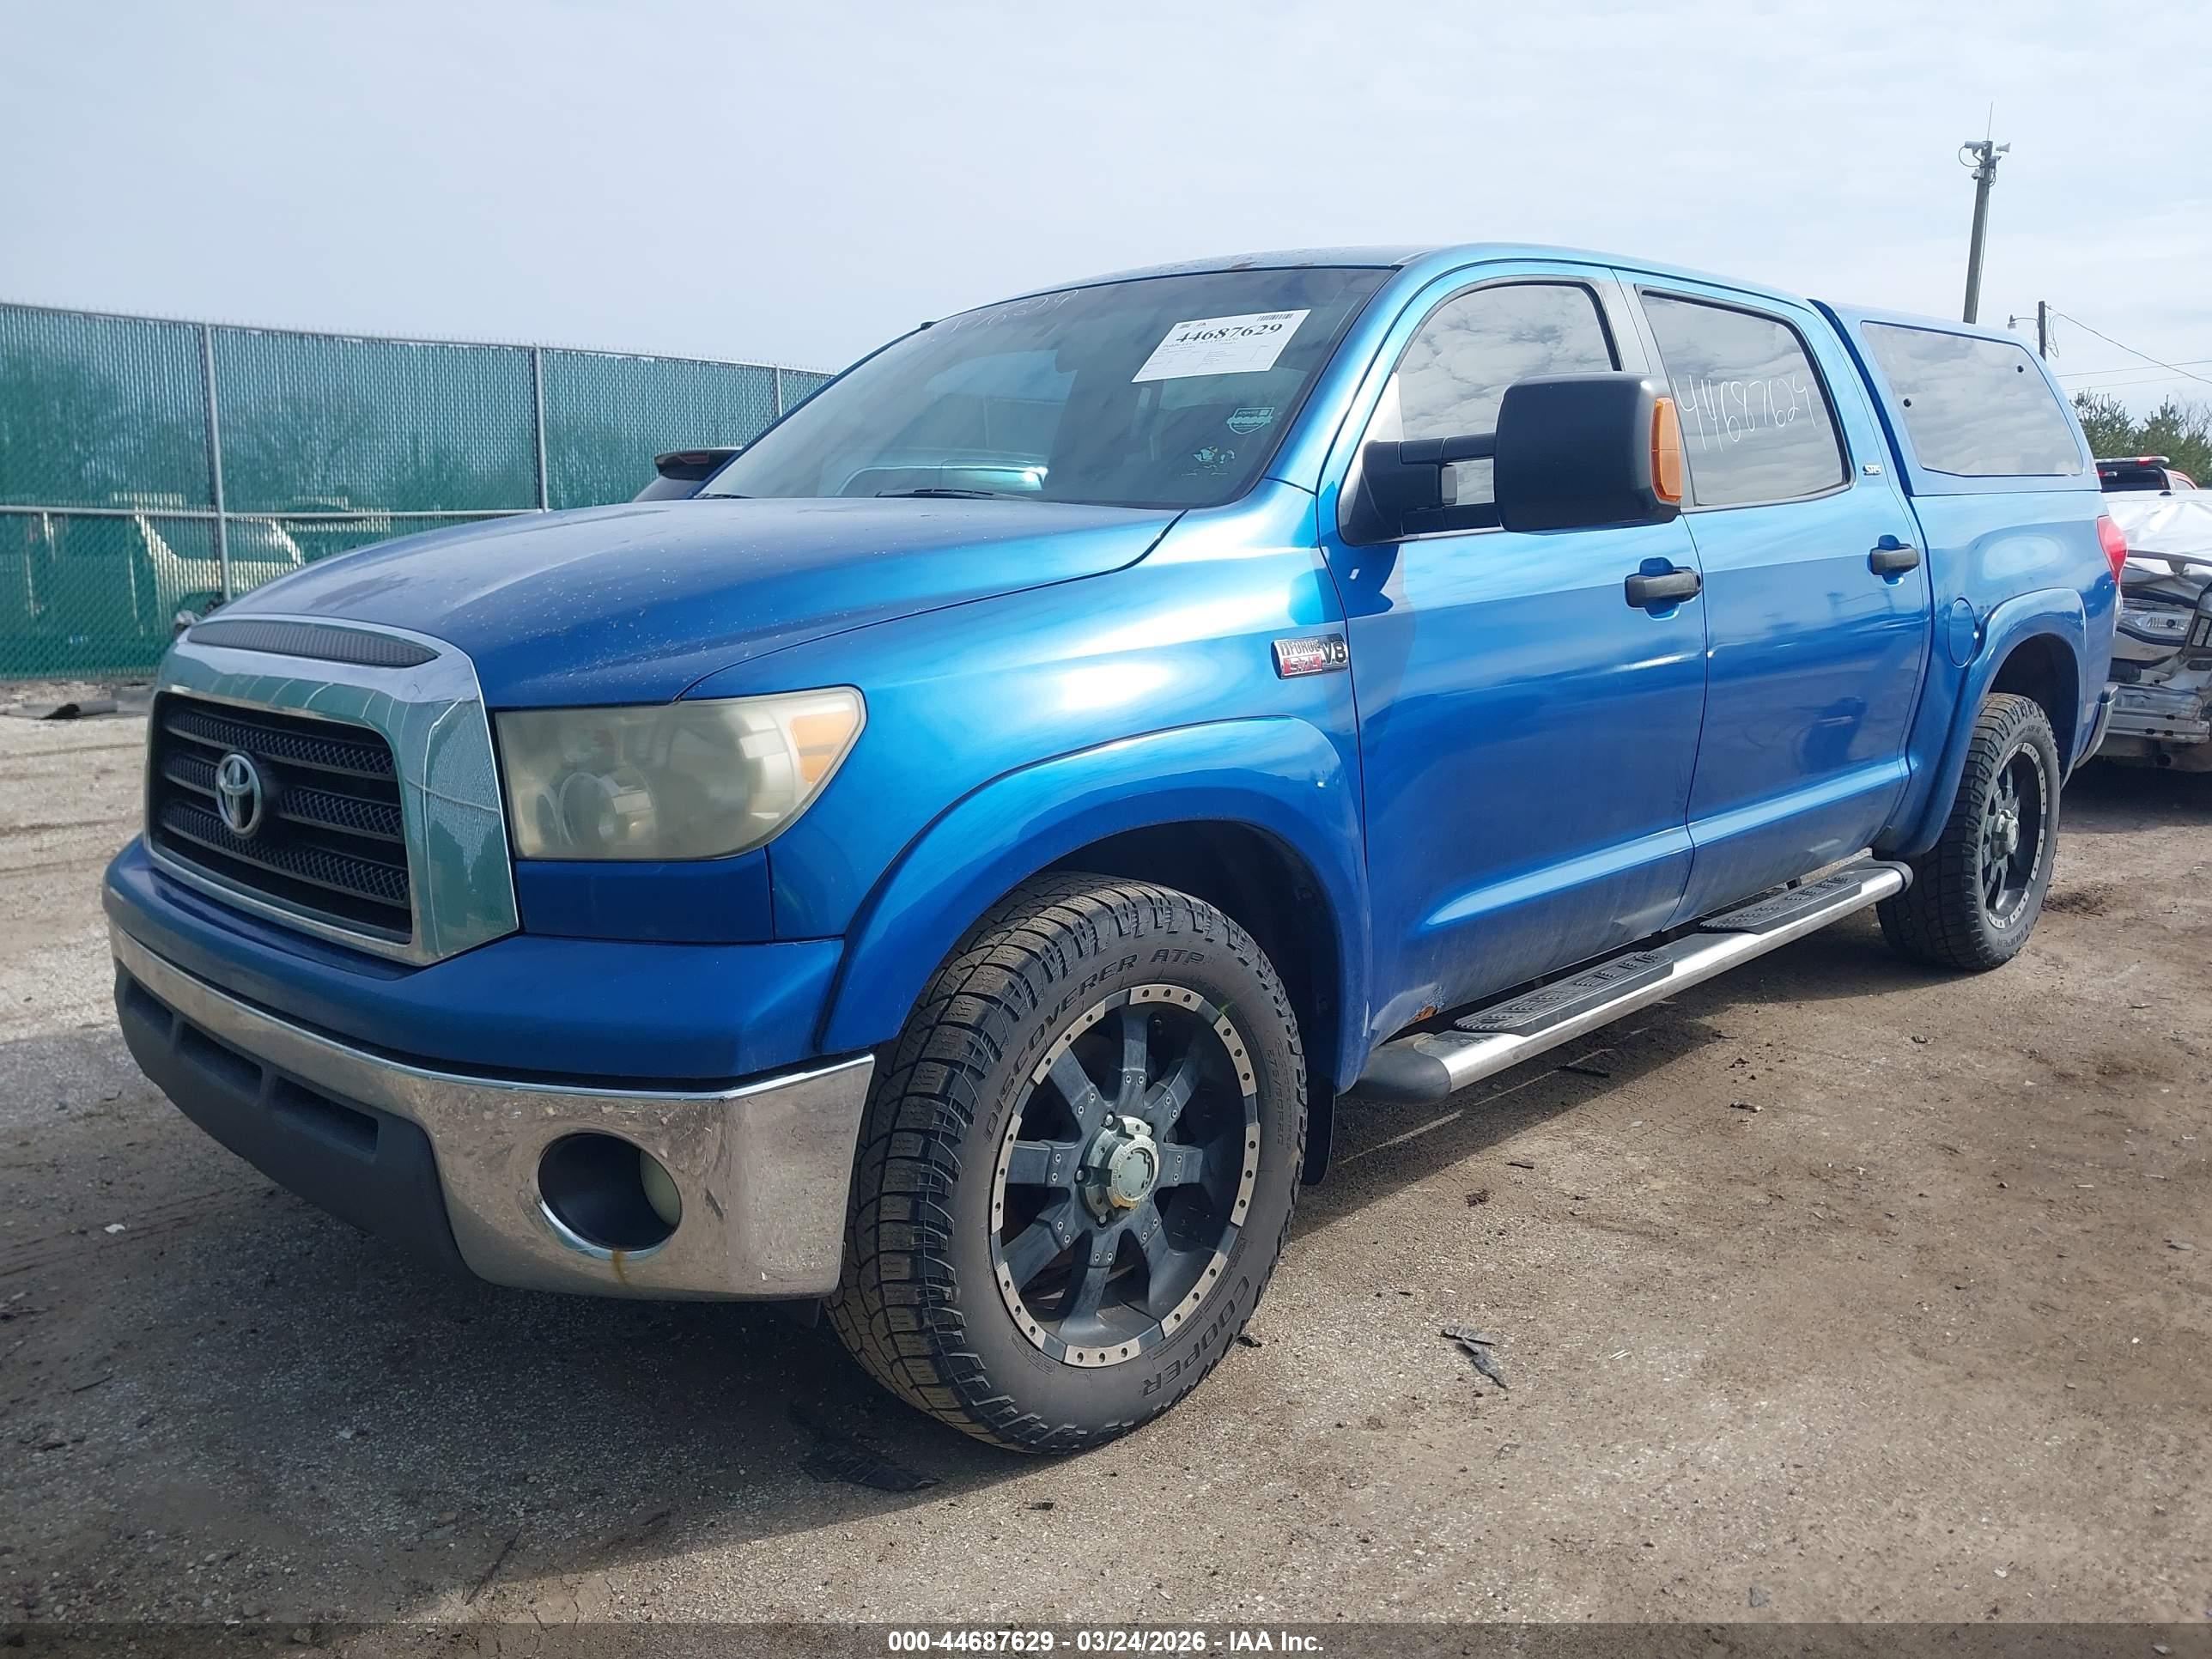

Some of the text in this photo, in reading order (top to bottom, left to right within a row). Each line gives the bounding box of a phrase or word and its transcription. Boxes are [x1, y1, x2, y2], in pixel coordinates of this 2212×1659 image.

[1176, 323, 1284, 343] 44687629
[1673, 374, 1817, 452] 44687629
[1322, 641, 1347, 665] V8
[984, 948, 1205, 1142] DISCOVERER ATP
[1143, 1275, 1250, 1396] COOPER
